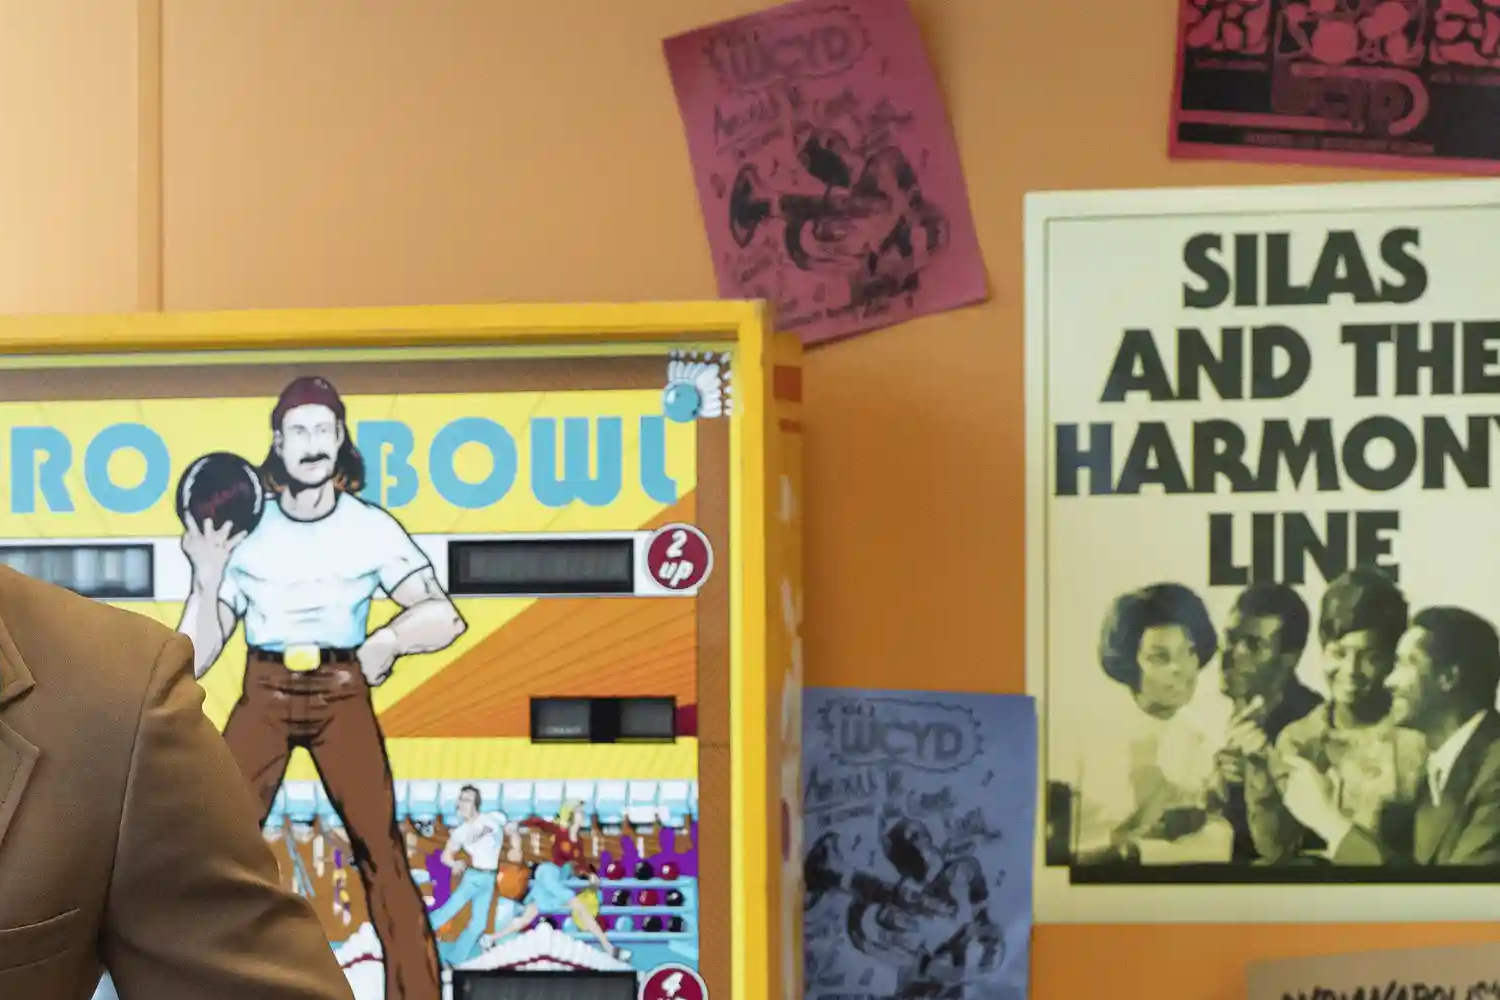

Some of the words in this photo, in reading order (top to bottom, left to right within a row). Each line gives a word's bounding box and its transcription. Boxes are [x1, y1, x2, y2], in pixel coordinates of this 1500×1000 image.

[1182, 227, 1428, 309] SILAS
[1099, 323, 1311, 402] AND
[1340, 320, 1500, 396] THE
[357, 416, 678, 508] BOWL
[1054, 414, 1500, 495] HARMON
[658, 560, 694, 587] up
[666, 530, 688, 558] 2
[1208, 510, 1400, 586] LINE
[661, 972, 684, 997] 4
